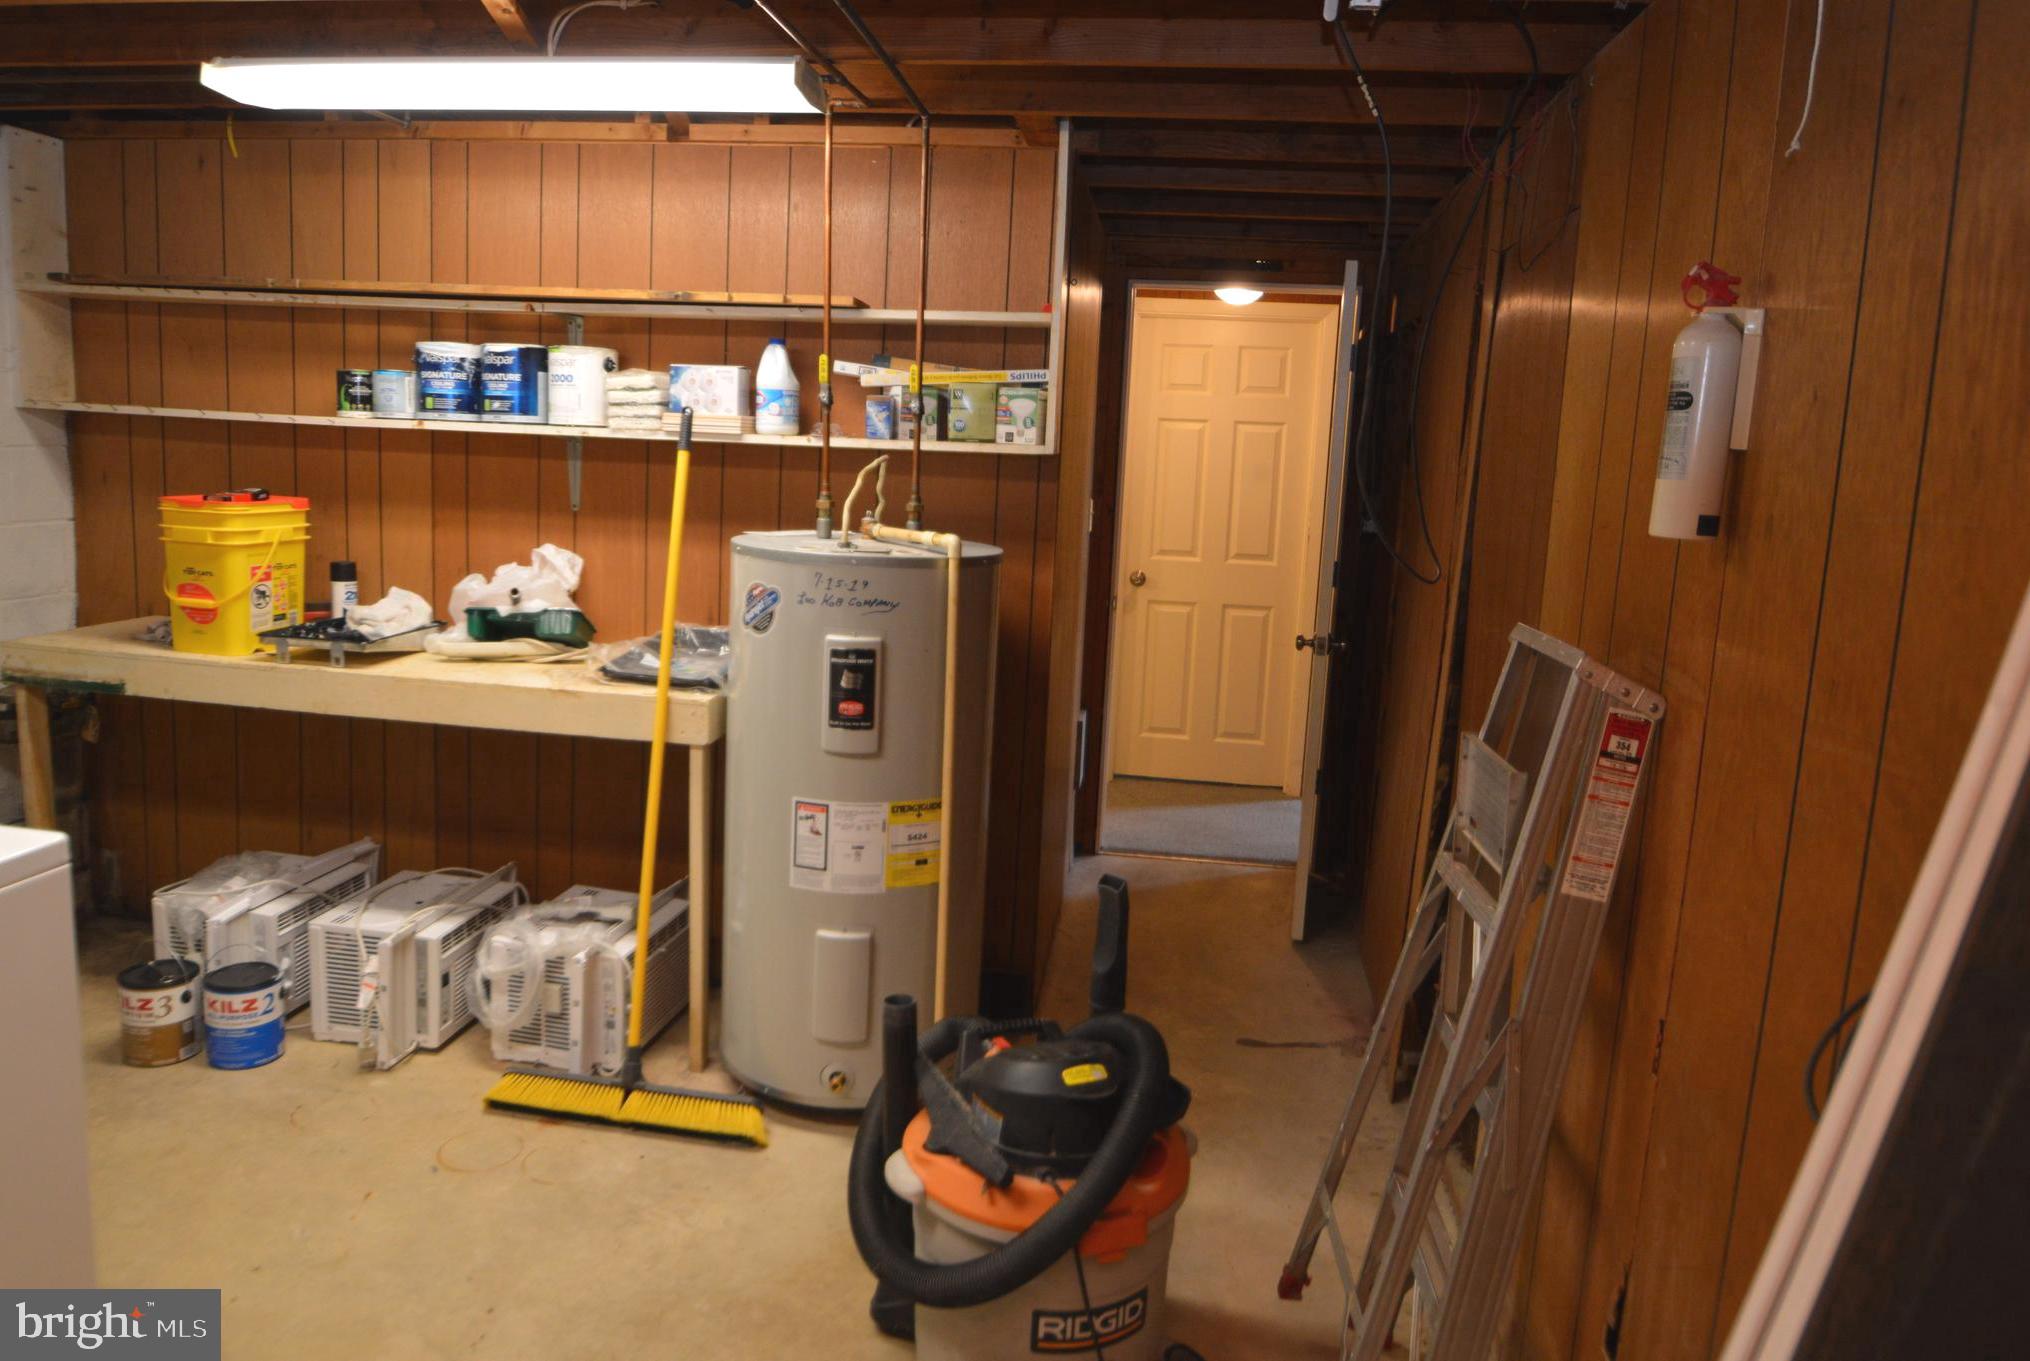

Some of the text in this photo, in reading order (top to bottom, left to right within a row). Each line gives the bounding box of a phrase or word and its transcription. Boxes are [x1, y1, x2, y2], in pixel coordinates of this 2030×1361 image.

[484, 353, 515, 366] alspar
[1010, 371, 1047, 381] PHILIPS
[121, 997, 153, 1011] ILZ
[154, 995, 173, 1018] 3
[207, 998, 258, 1013] KILZ
[259, 993, 275, 1016] 2
[1038, 1298, 1143, 1340] RIDGID
